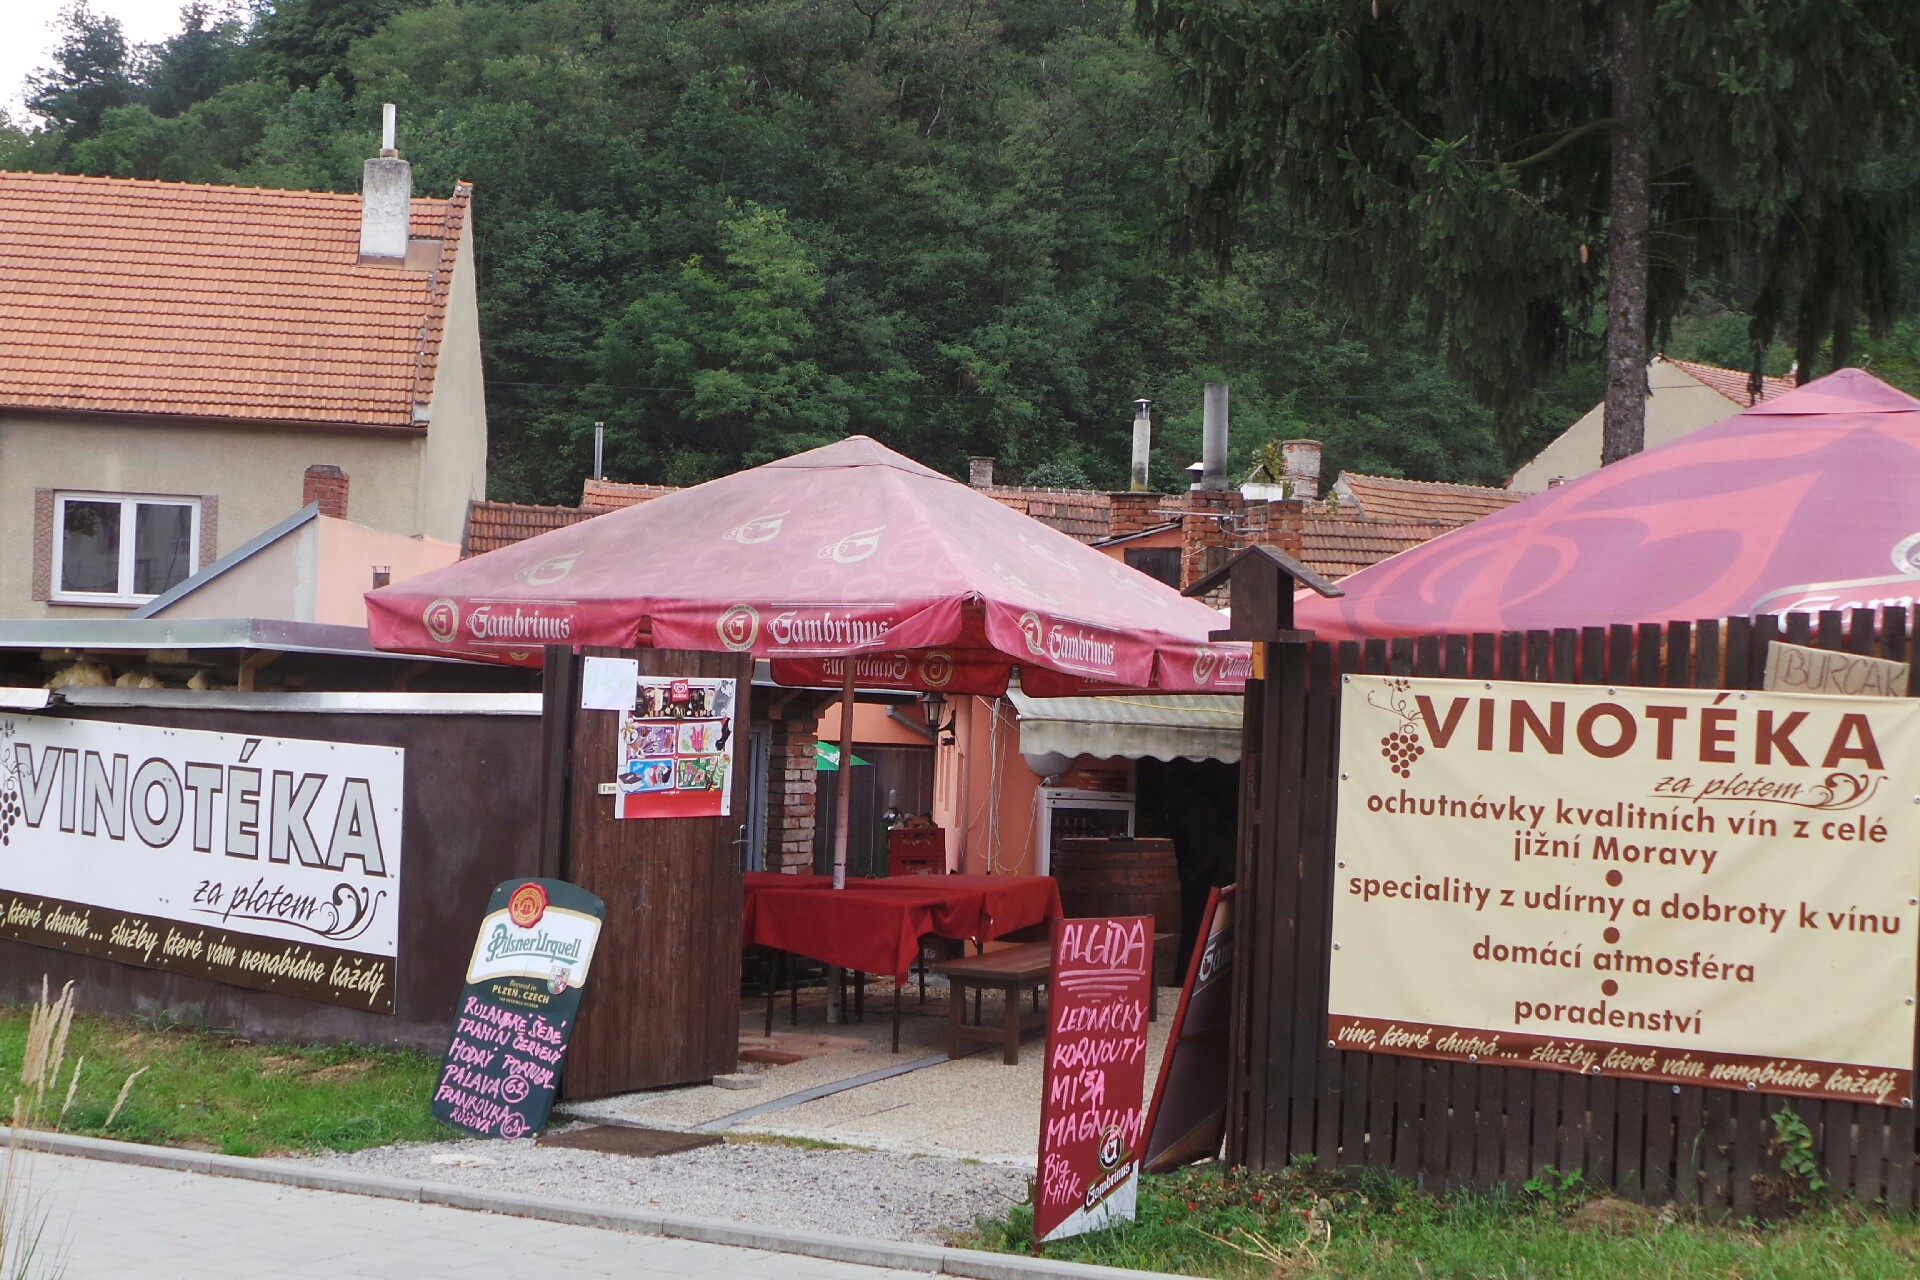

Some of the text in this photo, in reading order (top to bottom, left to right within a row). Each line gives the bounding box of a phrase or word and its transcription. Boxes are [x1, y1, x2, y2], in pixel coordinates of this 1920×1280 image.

[466, 605, 570, 639] Gambrinus
[767, 611, 889, 644] Gambrinus
[1047, 625, 1114, 665] Gambrinus
[1414, 693, 1884, 770] VINOTÉKA
[14, 739, 387, 878] VINOTÉKA
[1654, 773, 1803, 804] za plotem
[1367, 789, 1888, 843] ochutnávky kvalitních vín z celé
[1514, 830, 1718, 874] jižní Moravy
[193, 877, 318, 923] za plotem
[1349, 875, 1900, 935] speciality z udírny a dobroty k vínu
[7, 897, 43, 928] které
[109, 918, 159, 962] služby
[163, 926, 204, 960] které
[206, 935, 236, 966] vám
[239, 946, 326, 983] nenabídne
[329, 956, 386, 1006] každý
[485, 923, 581, 962] Pilsner Urquell
[1473, 935, 1754, 983] domácí atmosféra
[523, 991, 550, 1004] CZECH
[1514, 1000, 1703, 1035] poradenství
[1053, 1036, 1146, 1069] KORNOUTY
[1338, 1020, 1376, 1049] víno,
[1380, 1024, 1432, 1050] které
[1529, 1041, 1599, 1074] služby
[1603, 1047, 1655, 1072] které
[1661, 1053, 1705, 1077] vám
[1710, 1060, 1820, 1089] nenabídne
[1824, 1068, 1897, 1104] každý
[1045, 1107, 1142, 1151] MAGNUM
[1044, 1153, 1070, 1188] Big
[1086, 1162, 1130, 1207] Gambrinus
